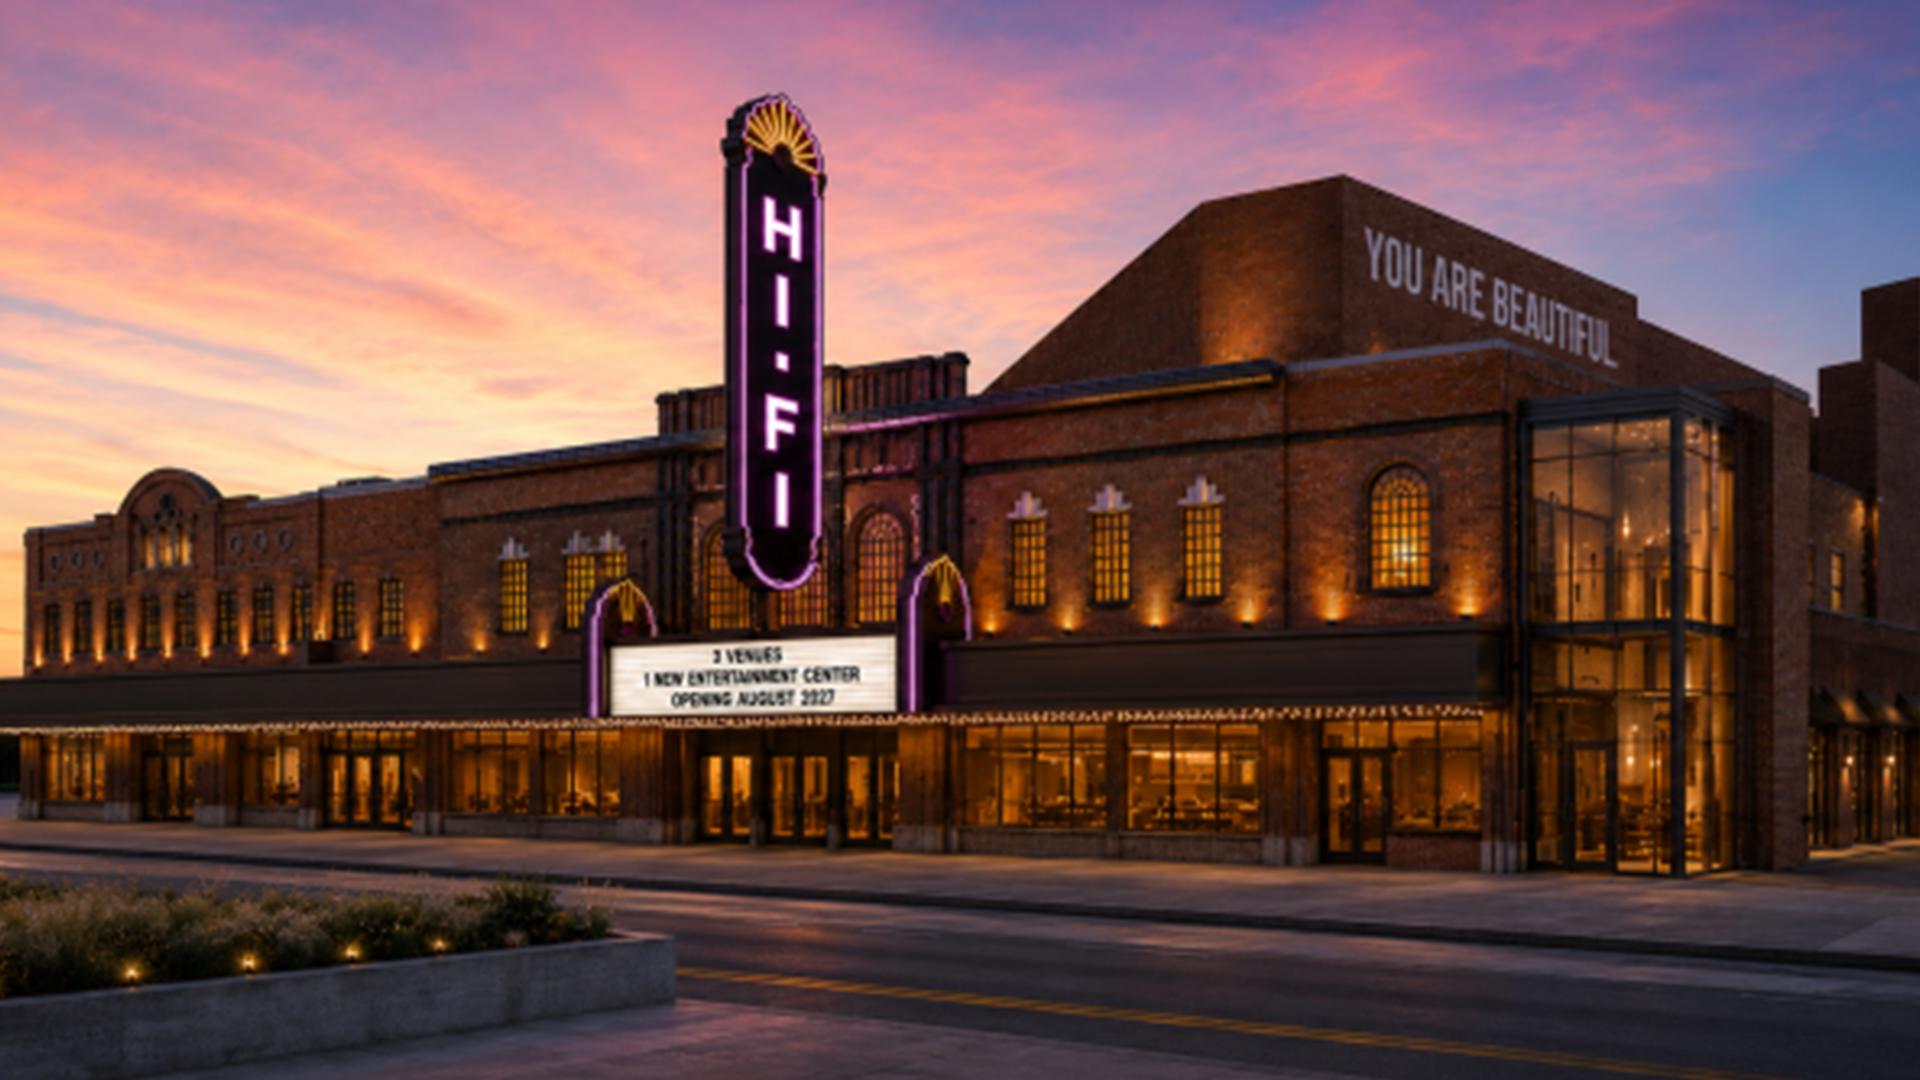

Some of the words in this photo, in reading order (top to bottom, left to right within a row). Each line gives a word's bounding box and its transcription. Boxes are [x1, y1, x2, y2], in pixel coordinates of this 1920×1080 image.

[1364, 226, 1422, 295] YOU
[1431, 256, 1486, 320] ARE
[1492, 277, 1619, 368] BEAUTIFUL
[727, 647, 783, 664] VENUES
[688, 668, 799, 686] ENTERTAINMENT
[803, 666, 861, 683] CENTER
[670, 691, 732, 708] OPENING
[737, 690, 795, 706] AUGUST
